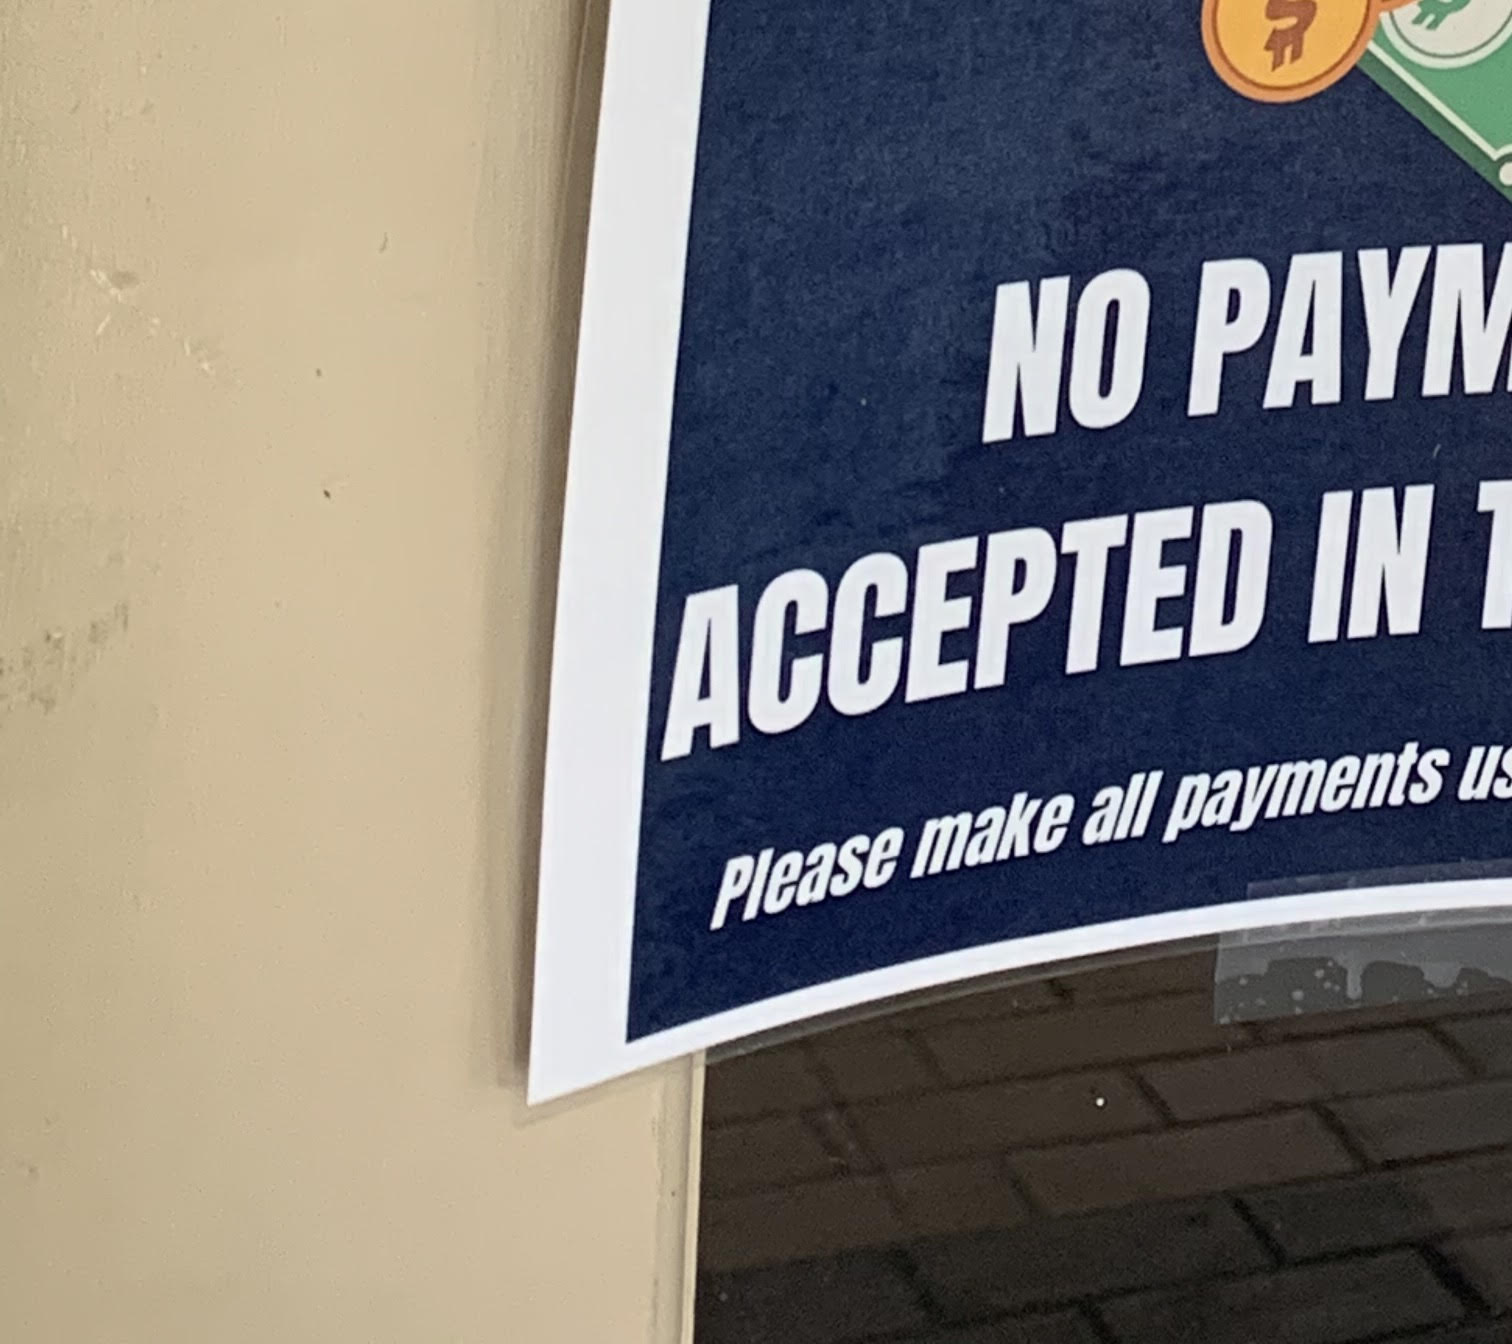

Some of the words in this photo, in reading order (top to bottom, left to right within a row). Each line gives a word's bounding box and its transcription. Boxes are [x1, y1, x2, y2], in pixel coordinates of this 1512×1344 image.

[979, 265, 1153, 446] NO
[658, 497, 1276, 764] ACCEPTED
[1305, 481, 1438, 646] IN
[707, 824, 907, 933] Please
[907, 789, 1078, 882] make
[1079, 767, 1167, 848] all
[1159, 738, 1453, 846] payments
